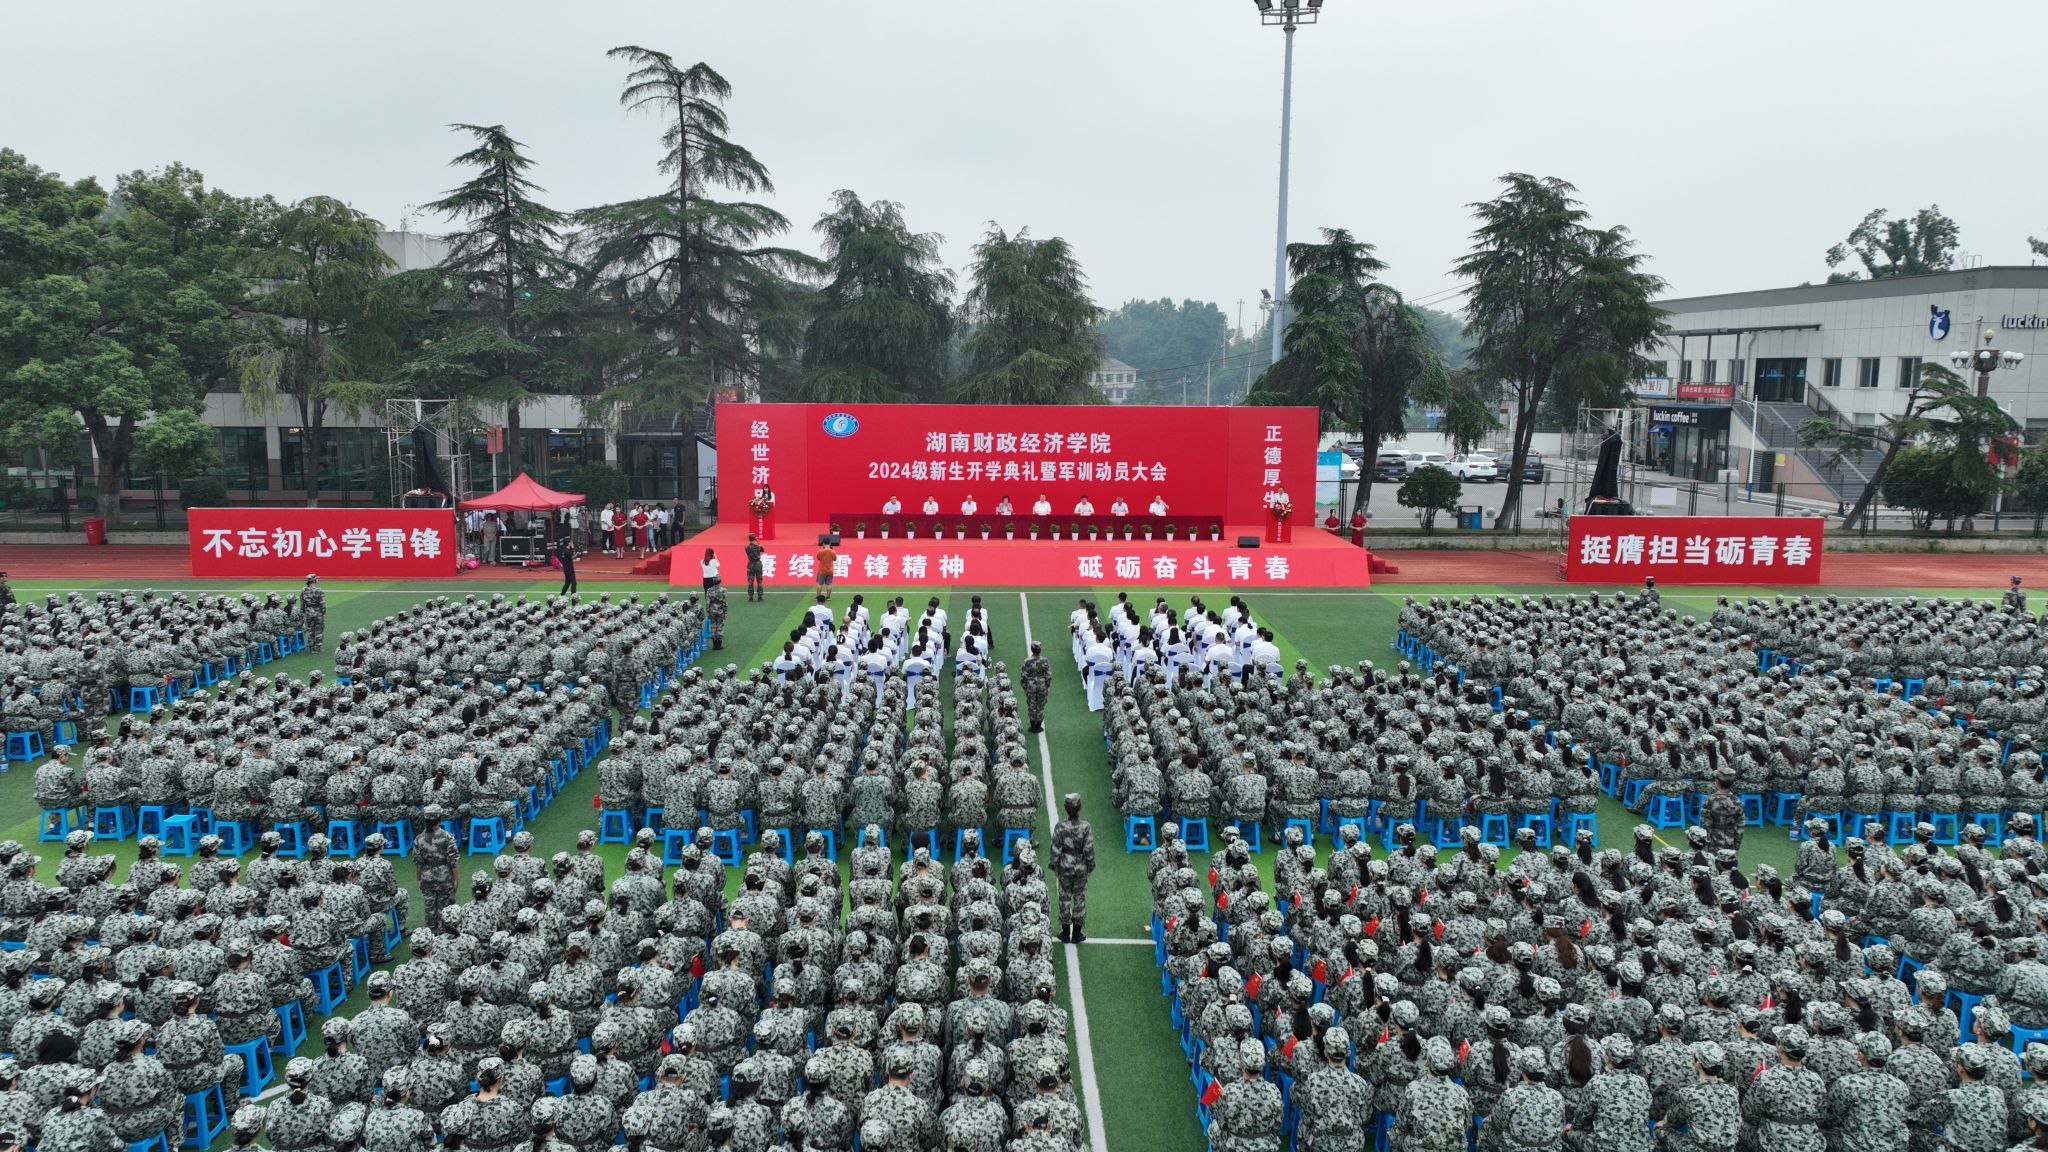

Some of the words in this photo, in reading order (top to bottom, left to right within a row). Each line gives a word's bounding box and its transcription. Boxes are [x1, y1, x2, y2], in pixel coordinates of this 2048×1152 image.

[2002, 313, 2048, 328] luckin
[1653, 410, 1671, 421] luckin
[1671, 411, 1690, 424] coffee
[925, 431, 1112, 454] 湖南财政经济学院
[750, 420, 770, 498] 经世济
[868, 460, 1167, 482] 2024级新生开学典礼暨军训动员大会
[202, 527, 442, 559] 不忘初心学雷锋
[1580, 534, 1813, 566] 挺膺担当砺青春
[1077, 555, 1290, 580] 砥砺奋斗青春
